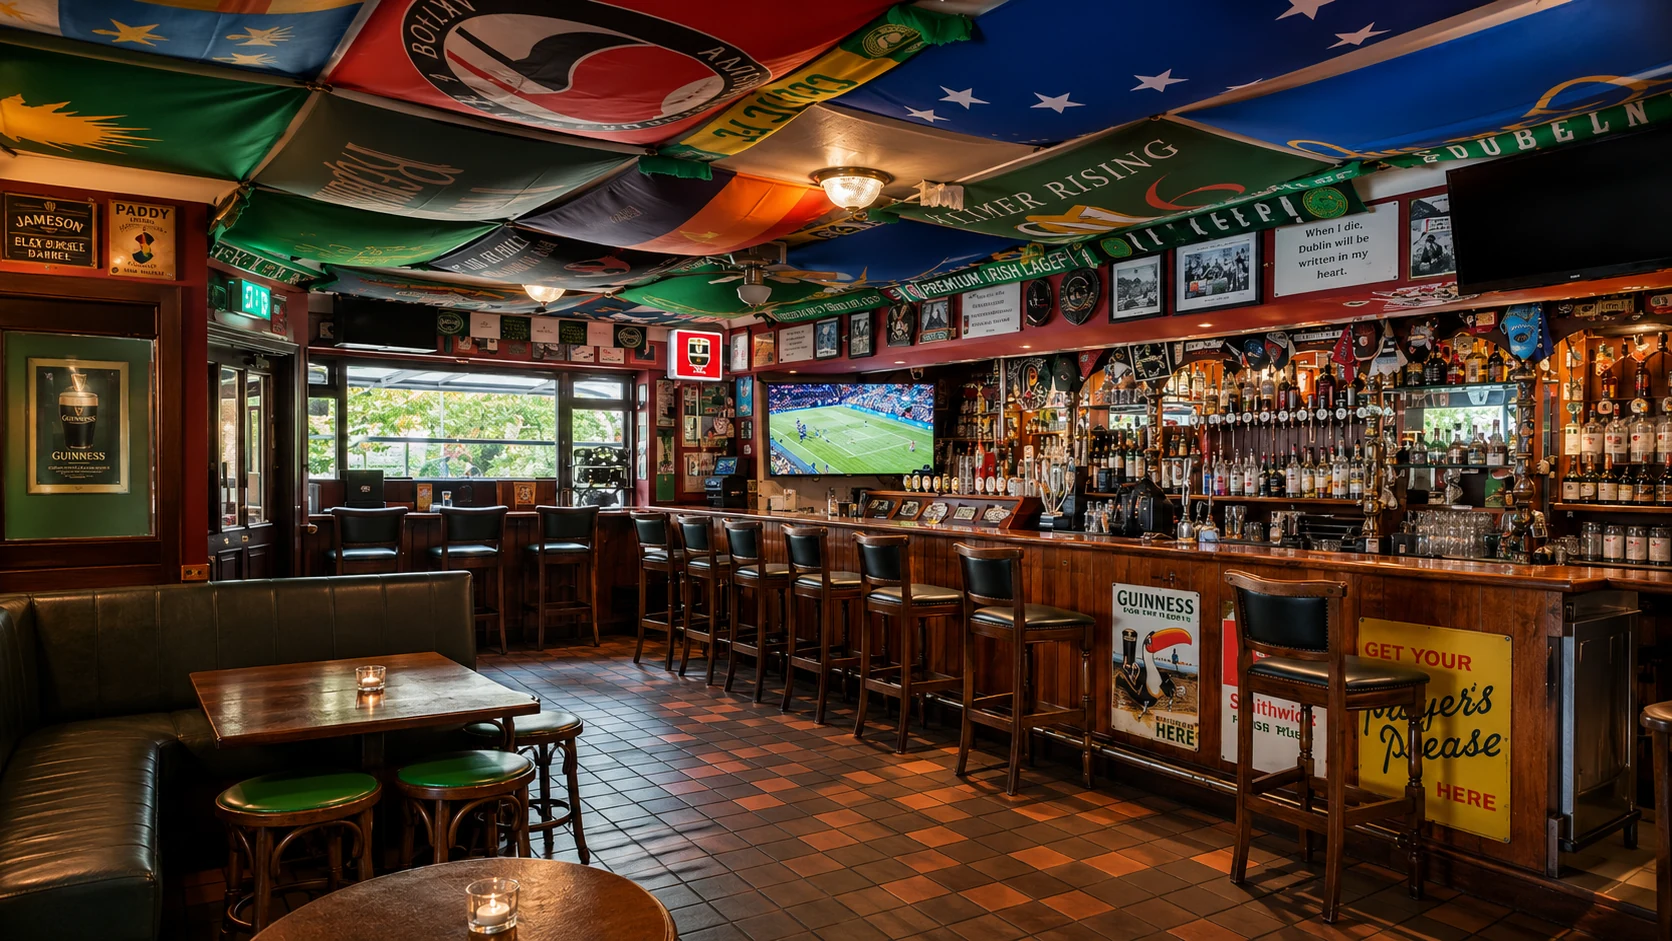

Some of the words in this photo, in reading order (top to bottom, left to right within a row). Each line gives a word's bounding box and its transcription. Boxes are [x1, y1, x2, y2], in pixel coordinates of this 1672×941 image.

[1043, 139, 1179, 201] RISING
[116, 203, 170, 220] PADDY
[16, 214, 84, 233] JAMESON
[1305, 226, 1334, 238] When
[1298, 241, 1332, 254] Dublin
[1335, 236, 1353, 247] will
[1356, 235, 1369, 244] be
[1298, 257, 1335, 268] written
[1339, 253, 1348, 261] in
[1352, 250, 1369, 260] my
[921, 272, 984, 295] PREMIUM
[1317, 268, 1347, 279] heart.
[52, 451, 106, 461] GUINNESS
[1117, 589, 1194, 615] GUINNESS
[1364, 641, 1404, 662] GET
[1410, 647, 1472, 672] YOUR
[1156, 721, 1195, 746] HERE
[1379, 724, 1501, 774] Pease
[1436, 781, 1497, 811] HERE
